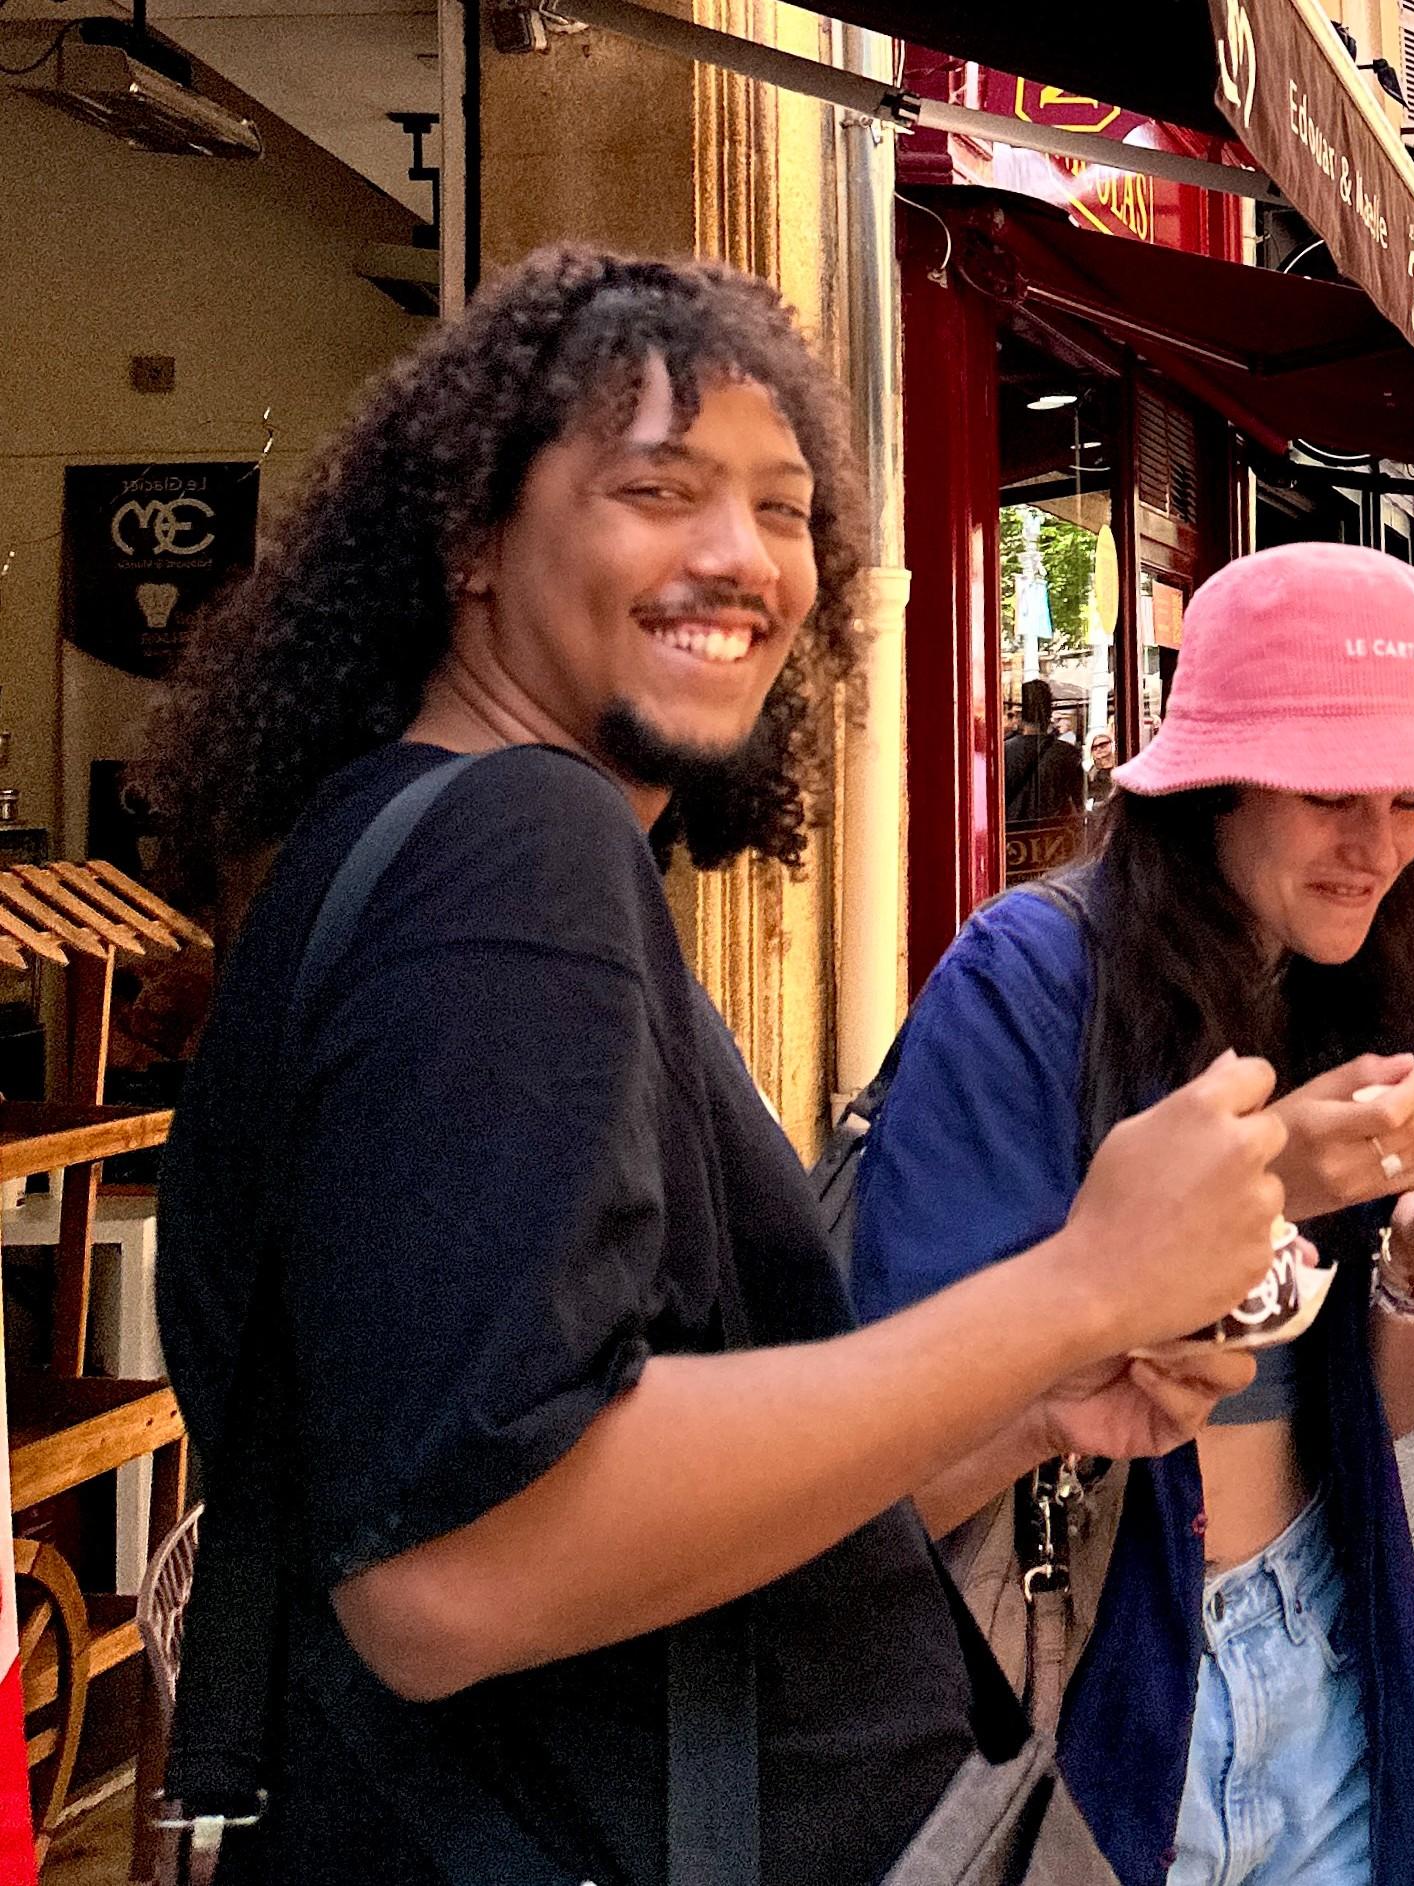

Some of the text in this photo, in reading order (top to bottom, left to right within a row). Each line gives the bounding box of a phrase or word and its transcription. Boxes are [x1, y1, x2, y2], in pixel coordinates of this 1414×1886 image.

[1289, 79, 1336, 182] Edouar
[1339, 155, 1353, 207] &
[1345, 638, 1366, 656] LE
